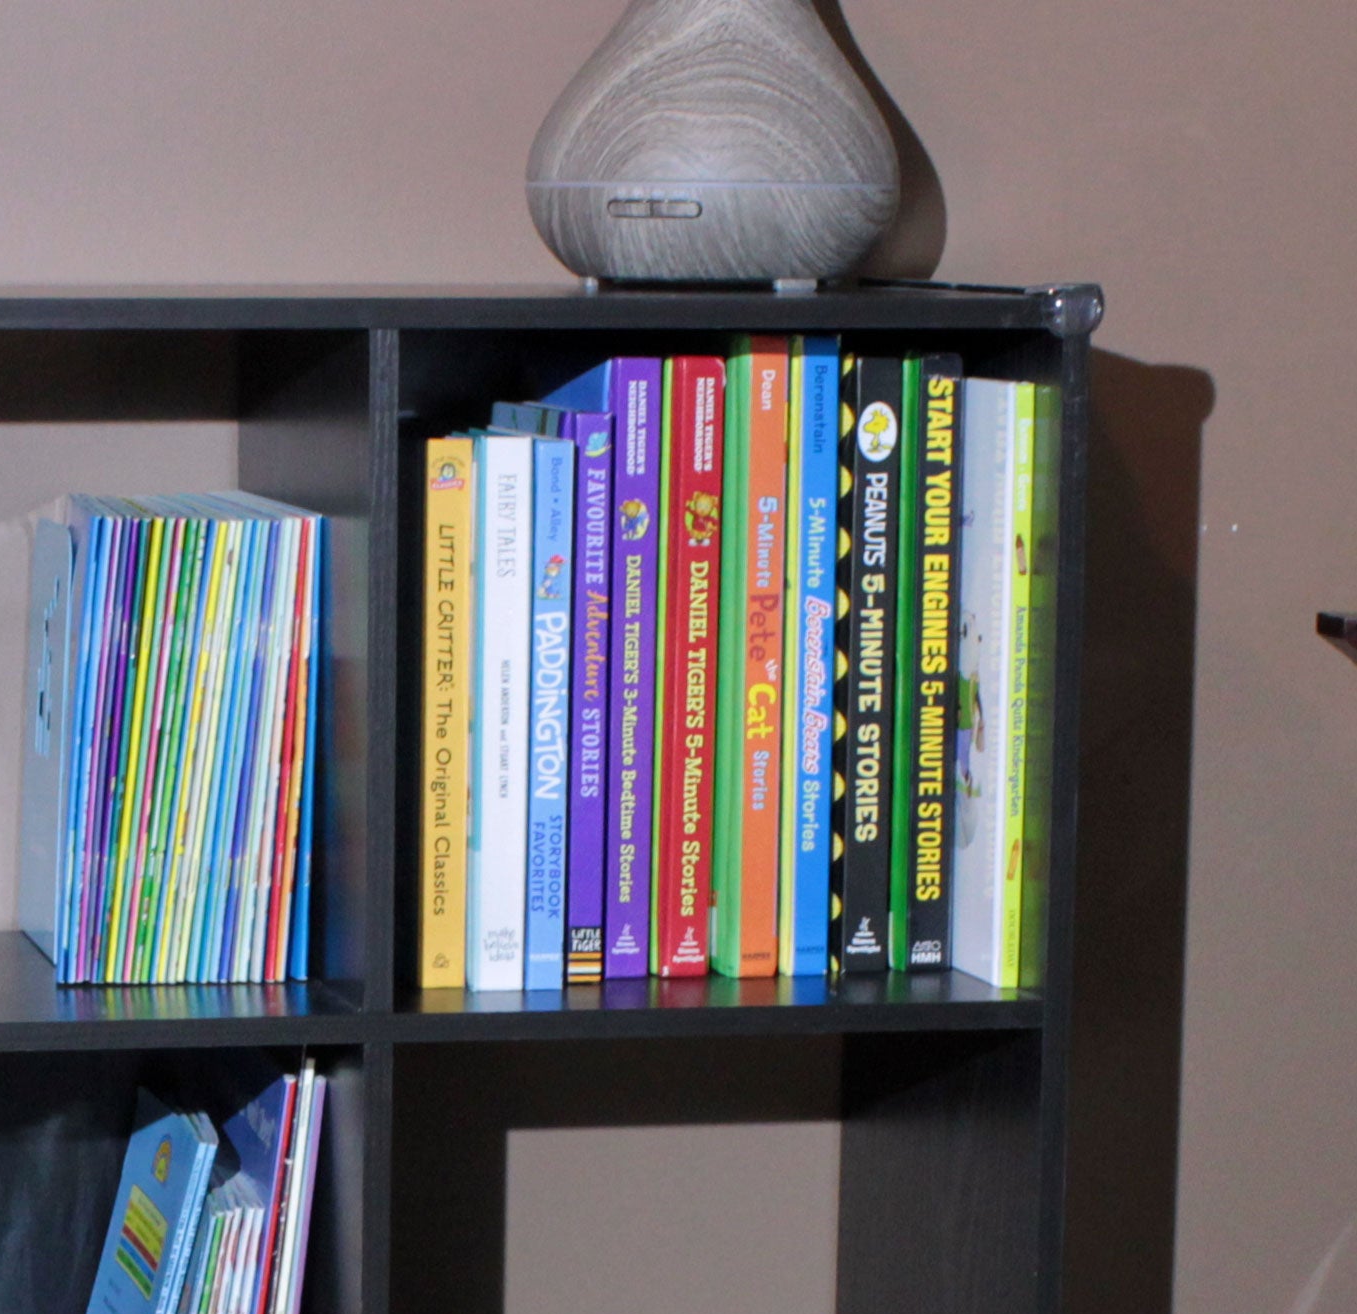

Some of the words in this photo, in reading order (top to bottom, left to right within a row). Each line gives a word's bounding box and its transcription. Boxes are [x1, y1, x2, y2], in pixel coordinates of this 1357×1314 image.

[626, 380, 638, 476] NEIGHBORHOOD
[637, 380, 647, 430] DANIEL
[694, 377, 706, 473] NEIGHBORHOOD
[706, 377, 715, 423] DANIEL
[761, 369, 776, 411] Dean
[815, 364, 828, 454] Berenstain
[926, 378, 954, 465] START
[498, 473, 517, 522] FAIRY
[551, 456, 564, 492] Bond
[923, 469, 951, 546] YOUR
[438, 523, 455, 591] LITTLE
[497, 528, 516, 579] TALES
[548, 508, 562, 542] Alley
[585, 468, 606, 584] FAVOURITE
[757, 497, 777, 588] 5-Minute
[807, 497, 827, 589] 5-Minute
[863, 472, 889, 567] PEANUTS
[624, 555, 642, 618] DANIEL
[689, 560, 710, 643] DANIEL
[921, 553, 950, 674] ENGINES
[584, 589, 608, 701] Adventure
[623, 622, 640, 684] TIGER'S
[749, 593, 779, 661] Pete
[803, 595, 831, 709] Berenstain
[857, 573, 885, 713] 5-MINUTE
[1015, 606, 1026, 655] Amanda
[685, 648, 708, 728] TIGER'S
[764, 658, 779, 681] the
[1014, 658, 1025, 693] Panda
[436, 699, 452, 739] The
[622, 689, 638, 765] 3-Minute
[746, 683, 777, 739] Cat
[801, 709, 828, 776] Bears
[918, 681, 945, 797] 5-MINUTE
[1012, 697, 1025, 731] Quits
[430, 748, 452, 829] Original
[581, 708, 600, 798] STORIES
[683, 734, 704, 834] 5-Minute
[752, 750, 771, 811] Stories
[855, 723, 880, 843] STORIES
[1005, 734, 1023, 816] Kindergarten
[620, 770, 636, 840] Bedtime
[801, 780, 820, 852] Stories
[433, 835, 452, 916] Classics
[531, 822, 545, 913] FAVORITES
[548, 815, 563, 918] STORYBOOK
[619, 844, 635, 903] Stories
[680, 841, 700, 916] Stories
[915, 802, 942, 901] STORIES
[571, 939, 602, 952] TIGER
[911, 951, 941, 964] HMH
